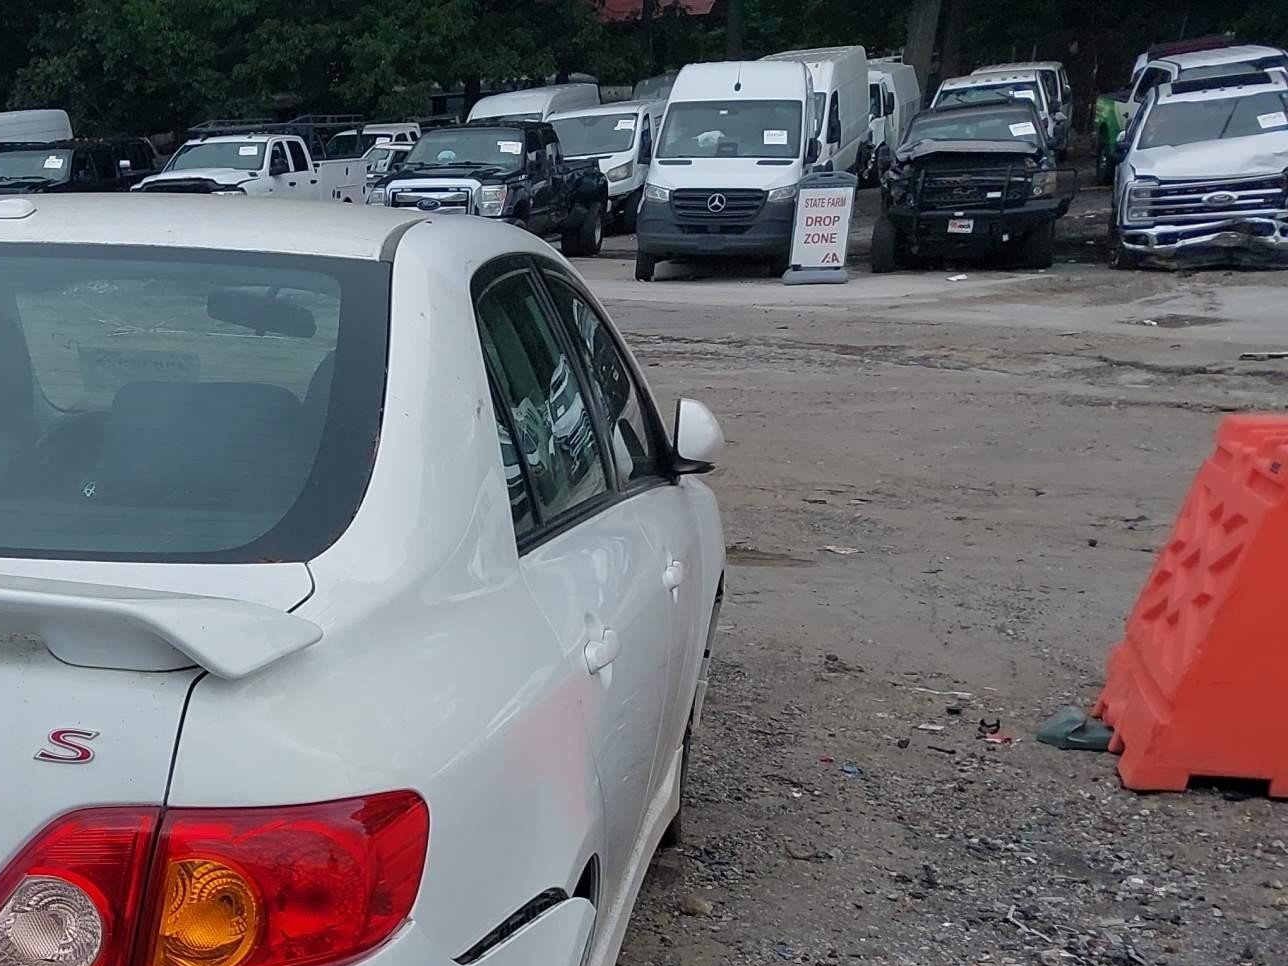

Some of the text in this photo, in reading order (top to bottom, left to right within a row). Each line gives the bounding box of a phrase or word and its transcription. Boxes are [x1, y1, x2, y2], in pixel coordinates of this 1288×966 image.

[804, 196, 847, 208] STATE FARM
[805, 215, 841, 227] DROP
[803, 232, 838, 245] ZONE
[32, 727, 101, 765] S
